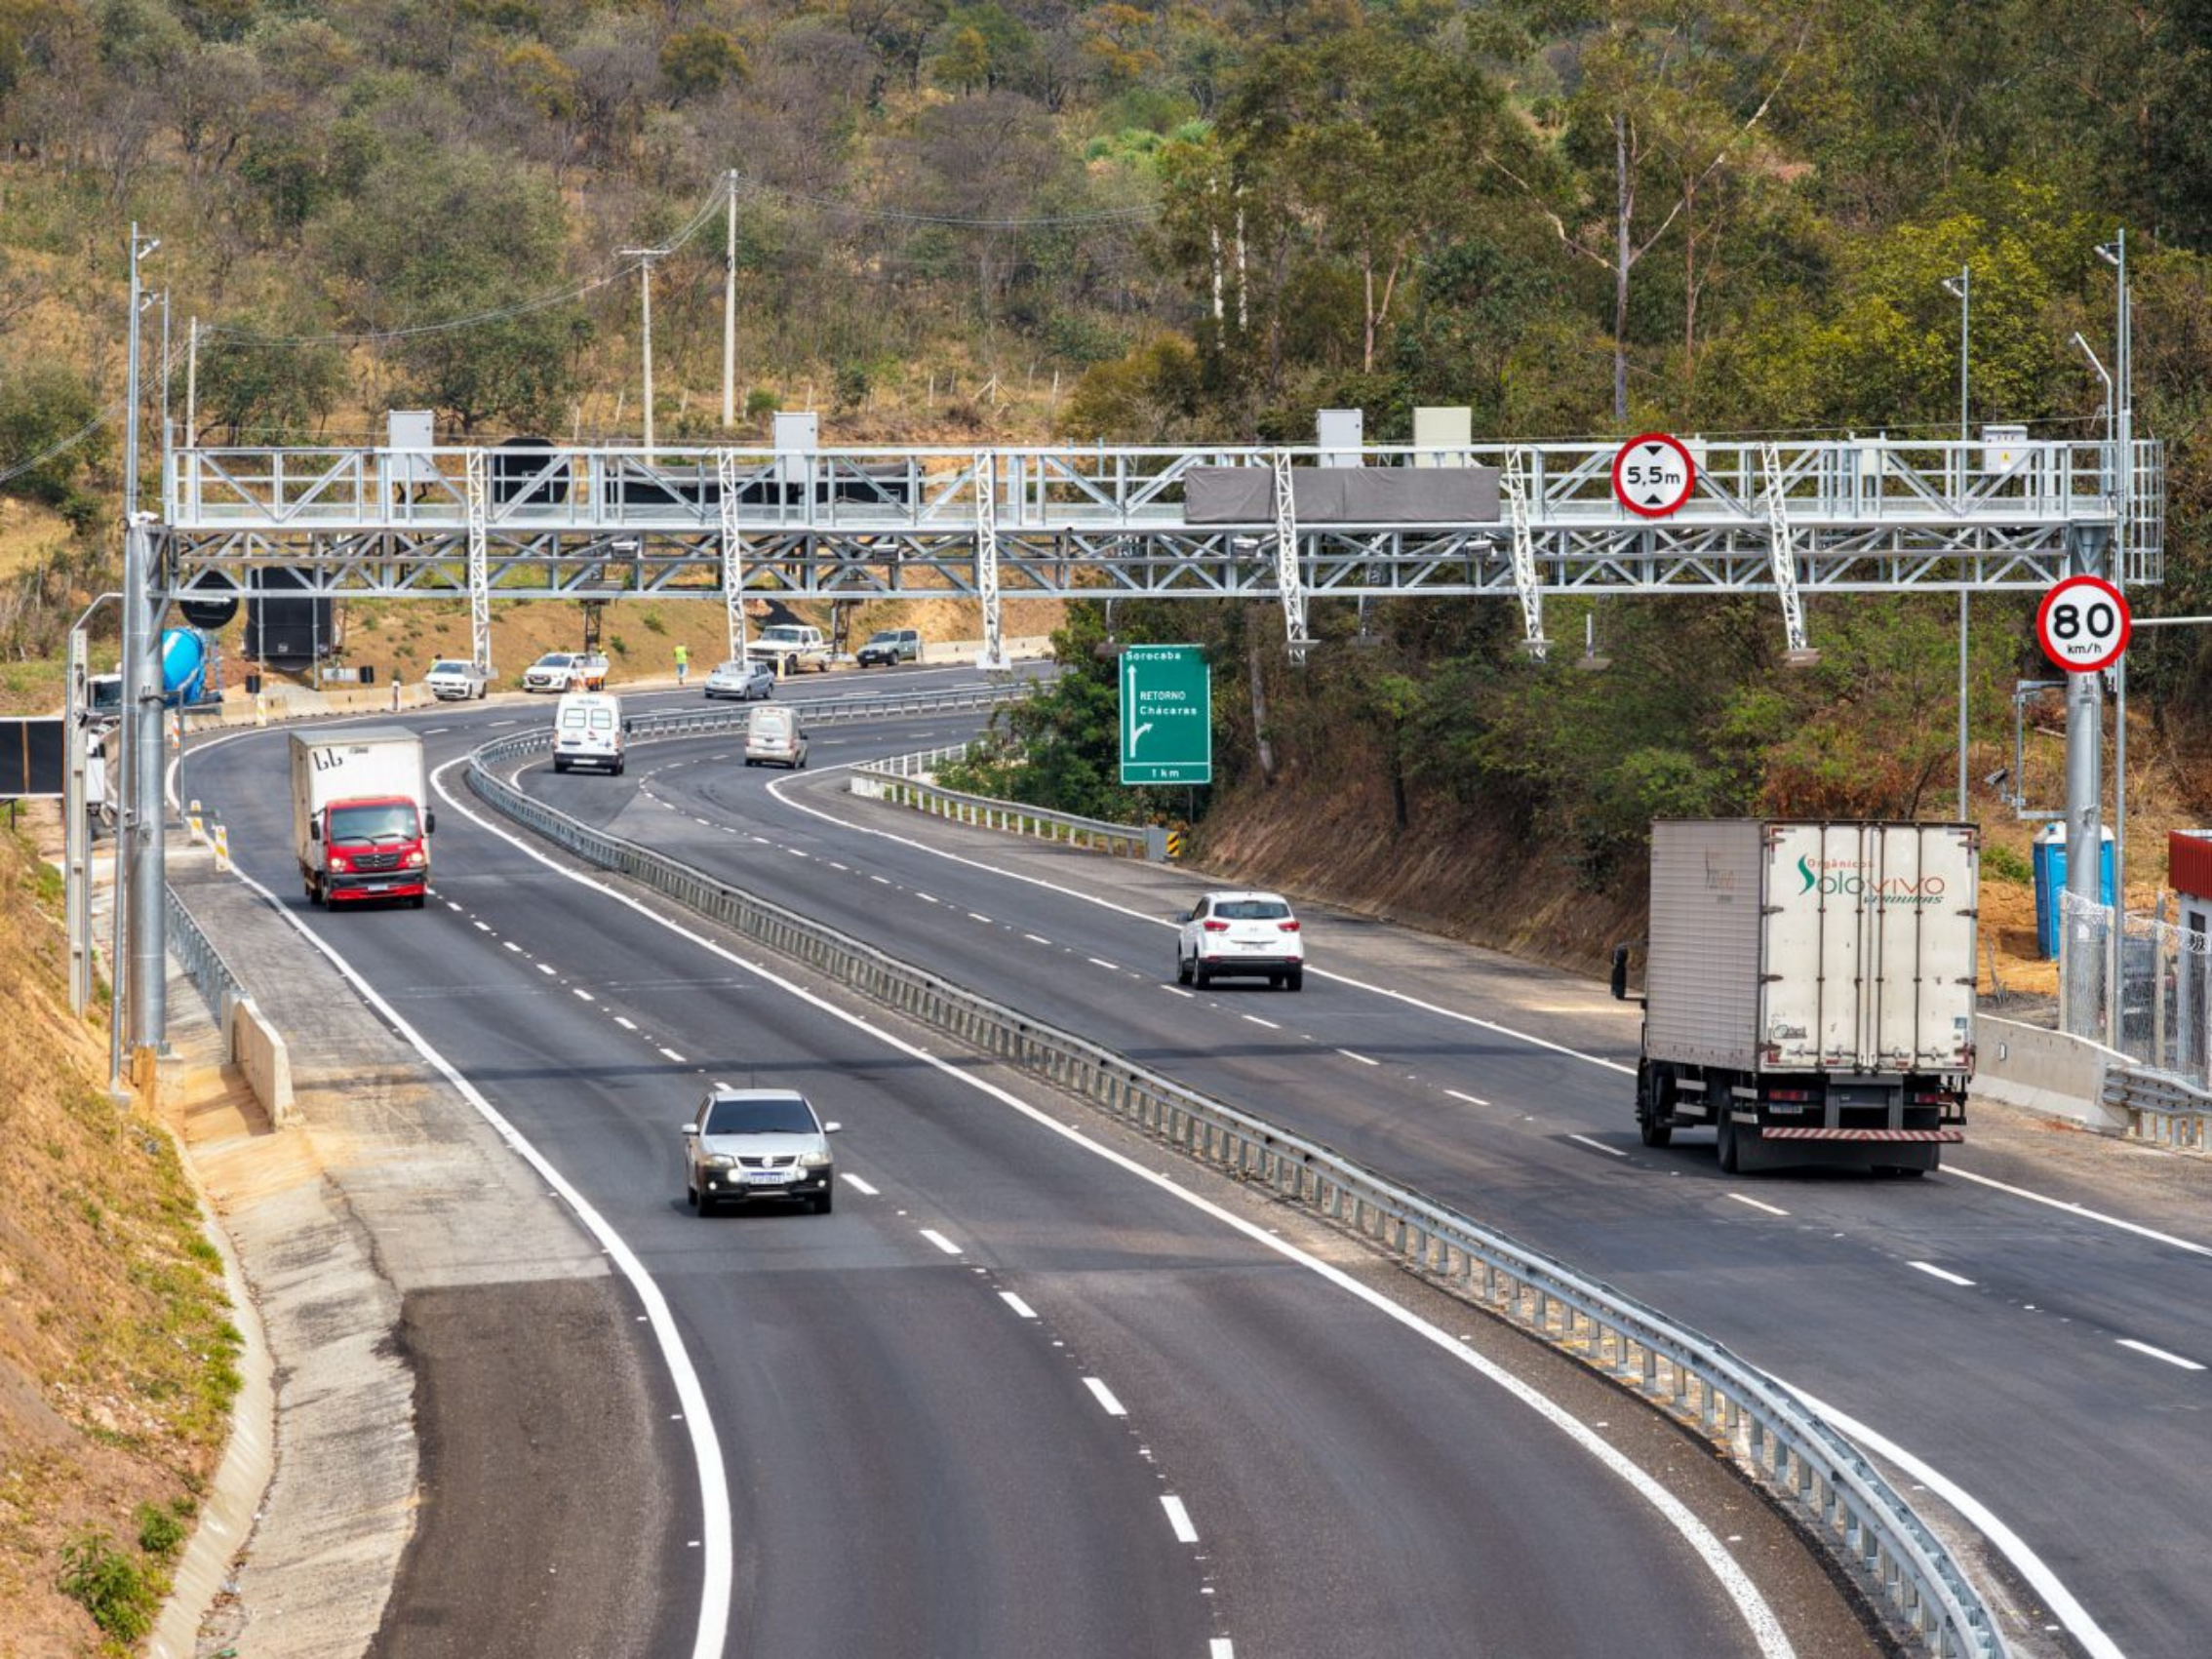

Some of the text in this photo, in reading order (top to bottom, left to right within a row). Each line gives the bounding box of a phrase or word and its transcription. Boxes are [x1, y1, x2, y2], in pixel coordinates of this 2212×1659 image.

[1627, 466, 1680, 486] 5,5m
[2053, 602, 2114, 640] 80
[2067, 643, 2102, 654] km/h
[1126, 651, 1181, 661] Sorocaba
[1139, 691, 1186, 701] RETORNO
[1139, 705, 1197, 716] Chácaras
[1151, 769, 1179, 777] 1 km
